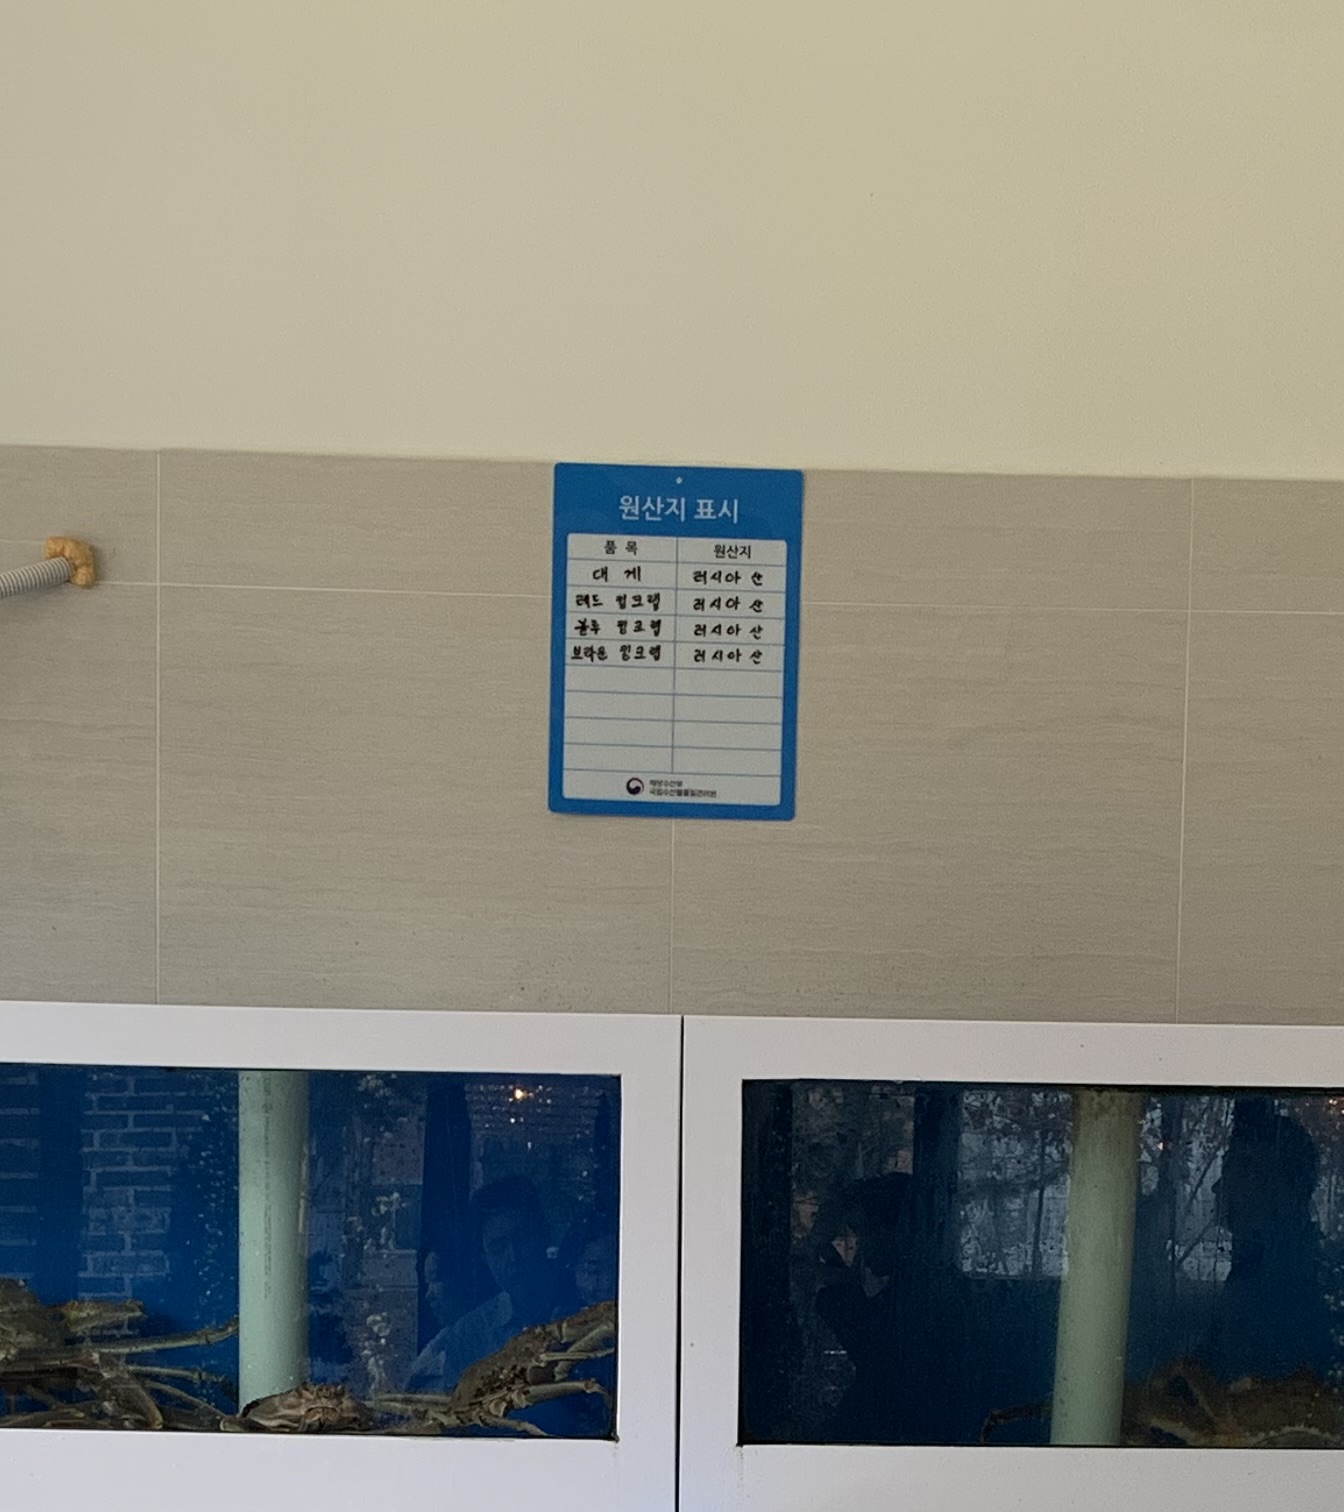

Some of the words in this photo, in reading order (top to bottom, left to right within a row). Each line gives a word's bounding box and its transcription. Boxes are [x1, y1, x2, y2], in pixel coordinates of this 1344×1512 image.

[619, 495, 685, 522] 원산지
[694, 498, 738, 524] 표시
[713, 544, 752, 559] 원산지
[575, 594, 603, 608] 레드
[571, 645, 608, 662] 브라운
